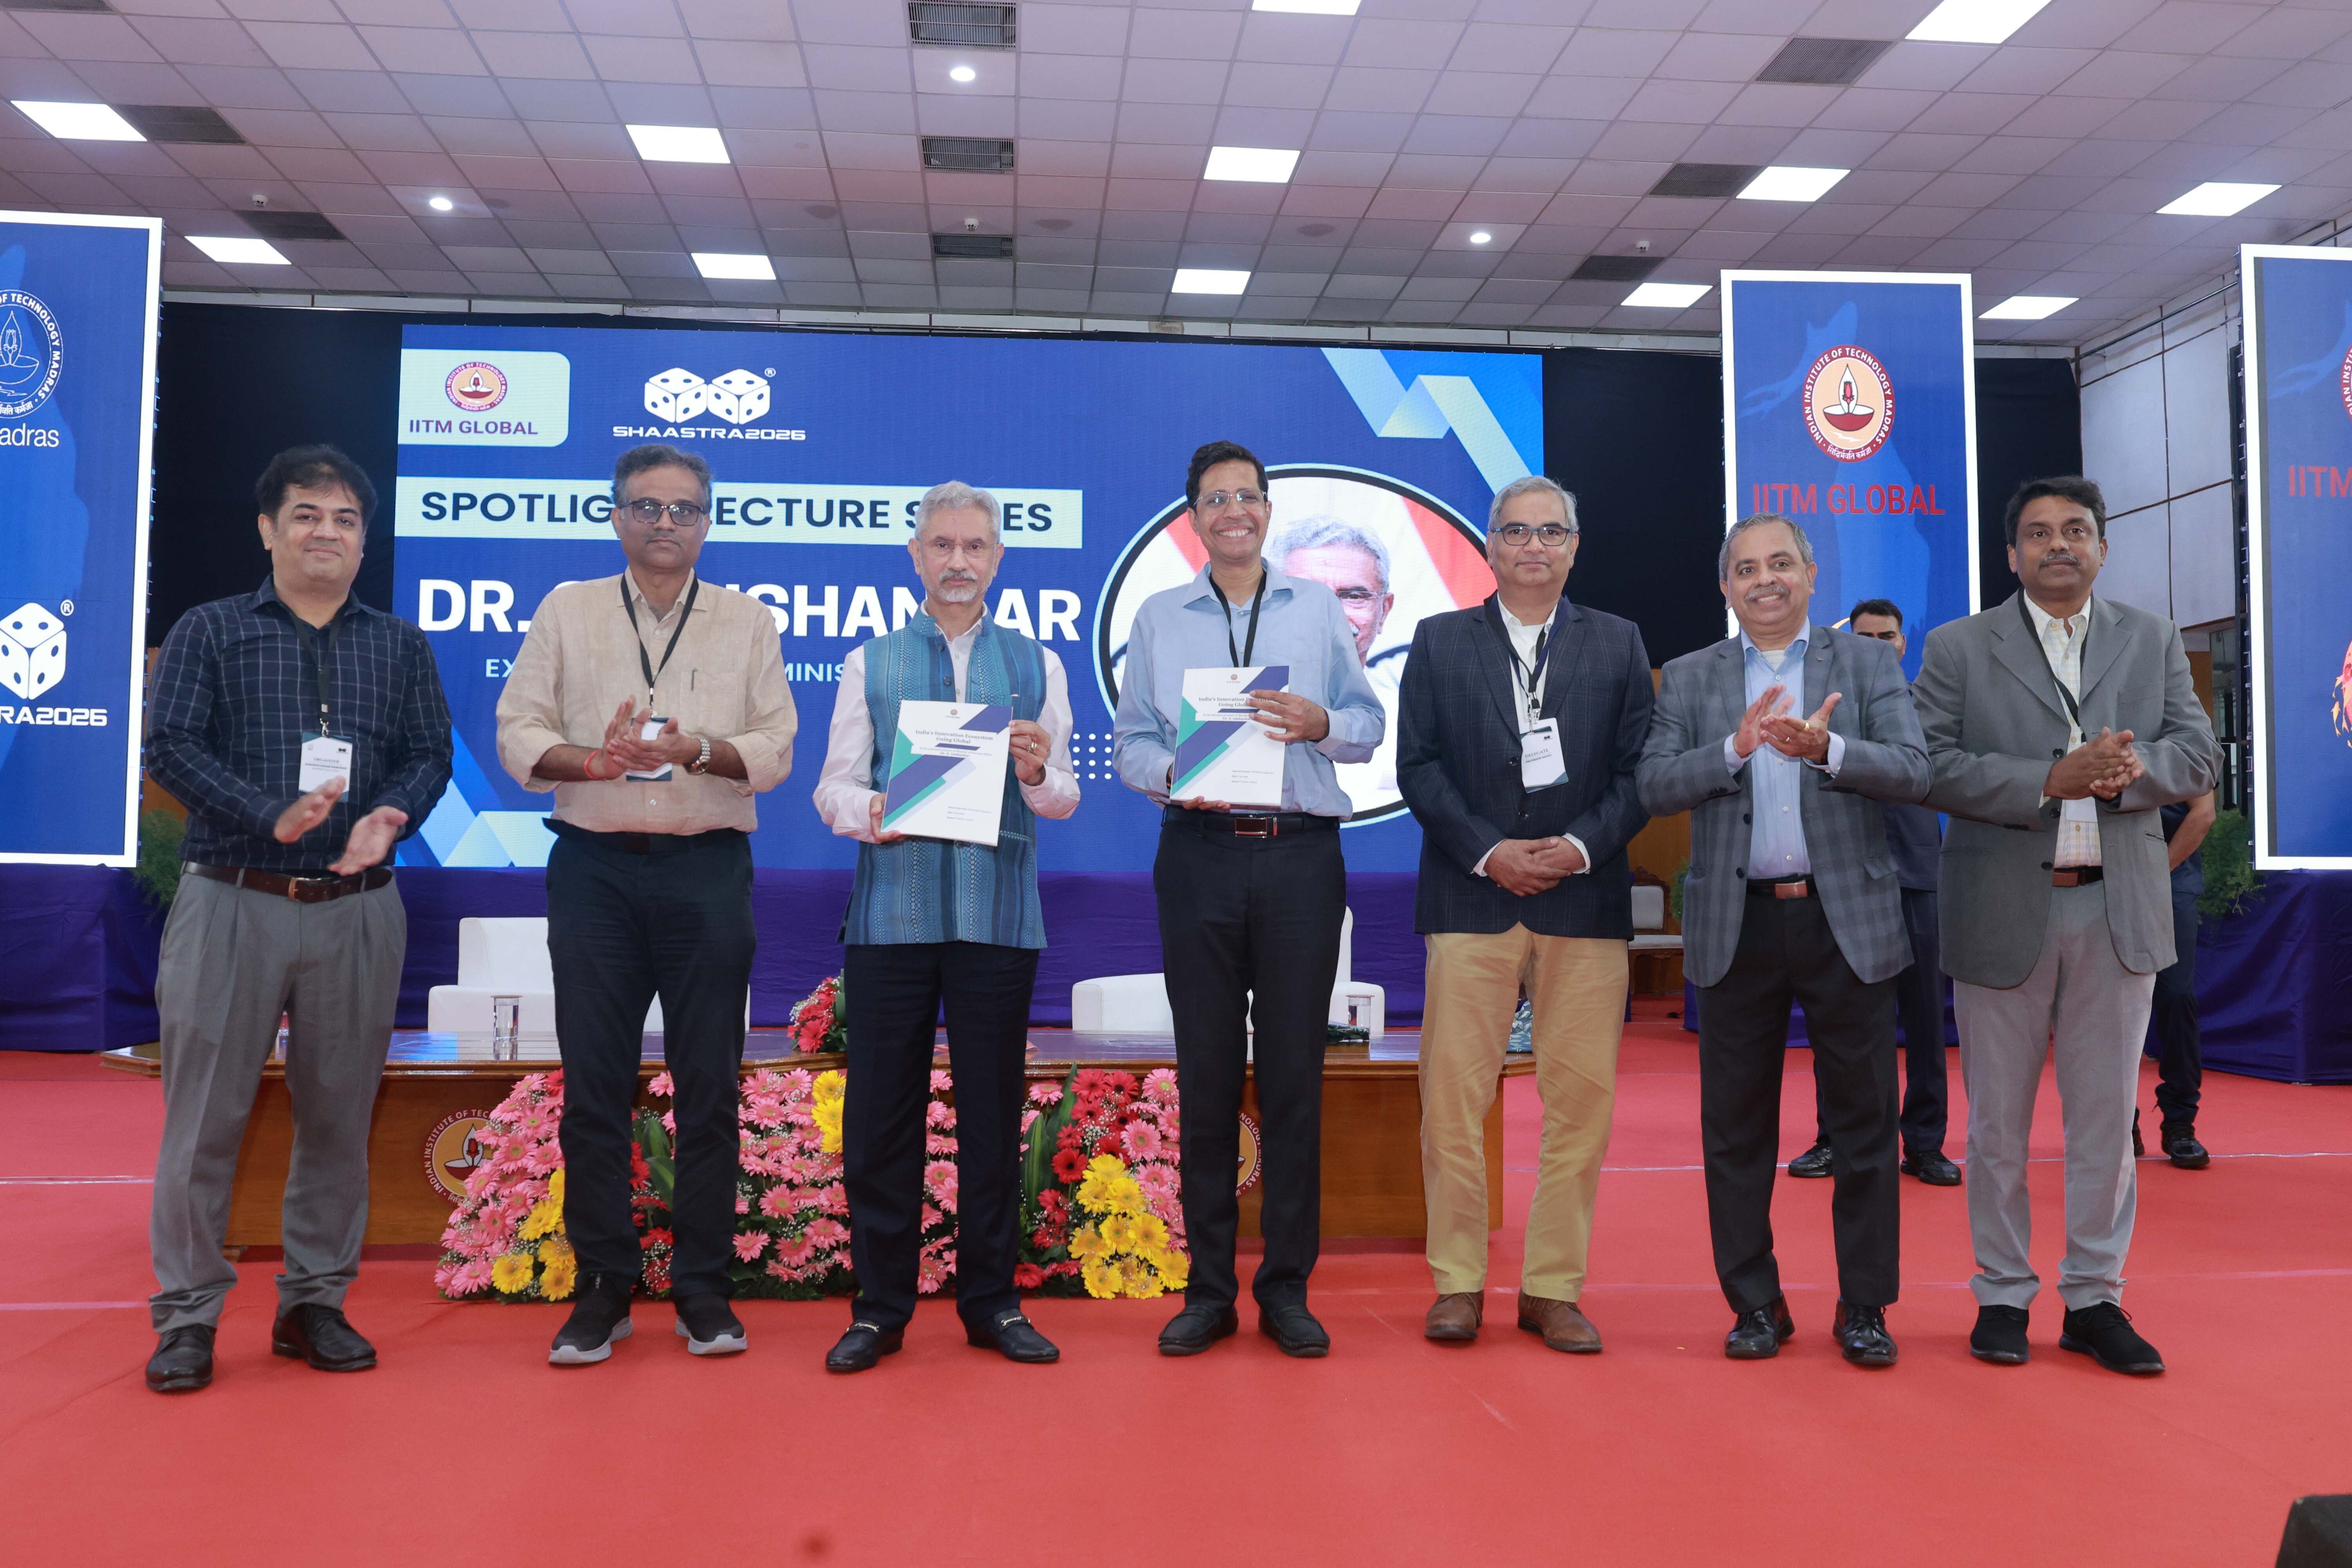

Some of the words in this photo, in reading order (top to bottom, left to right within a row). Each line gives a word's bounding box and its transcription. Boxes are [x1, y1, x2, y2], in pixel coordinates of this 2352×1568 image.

[11, 293, 60, 346] TECHNOLOGY
[38, 350, 60, 399] MADRAS
[1831, 348, 1842, 358] OF
[1804, 354, 1830, 402] INSTITUTE
[1845, 348, 1891, 395] TECHNOLOGY
[0, 423, 60, 448] adras
[410, 420, 452, 433] IITM
[459, 421, 538, 435] GLOBAL
[613, 426, 806, 441] SHAASTRA2026
[1805, 406, 1823, 444] INDIAN
[1875, 399, 1893, 444] MADRAS
[422, 492, 615, 523] SPOTLIG
[711, 497, 889, 528] ECTURE
[1753, 483, 1817, 514] IITM
[1827, 484, 1945, 515] GLOBAL
[418, 579, 532, 632] DR.
[486, 659, 516, 678] EX
[0, 706, 108, 727] RA2026
[1525, 749, 1548, 759] DELEGATE
[456, 1110, 468, 1119] OF
[472, 1109, 490, 1118] TEC
[1239, 1112, 1261, 1145] NOLOG
[424, 1115, 454, 1158] INSTITUTE
[425, 1161, 444, 1193] INDIAN
